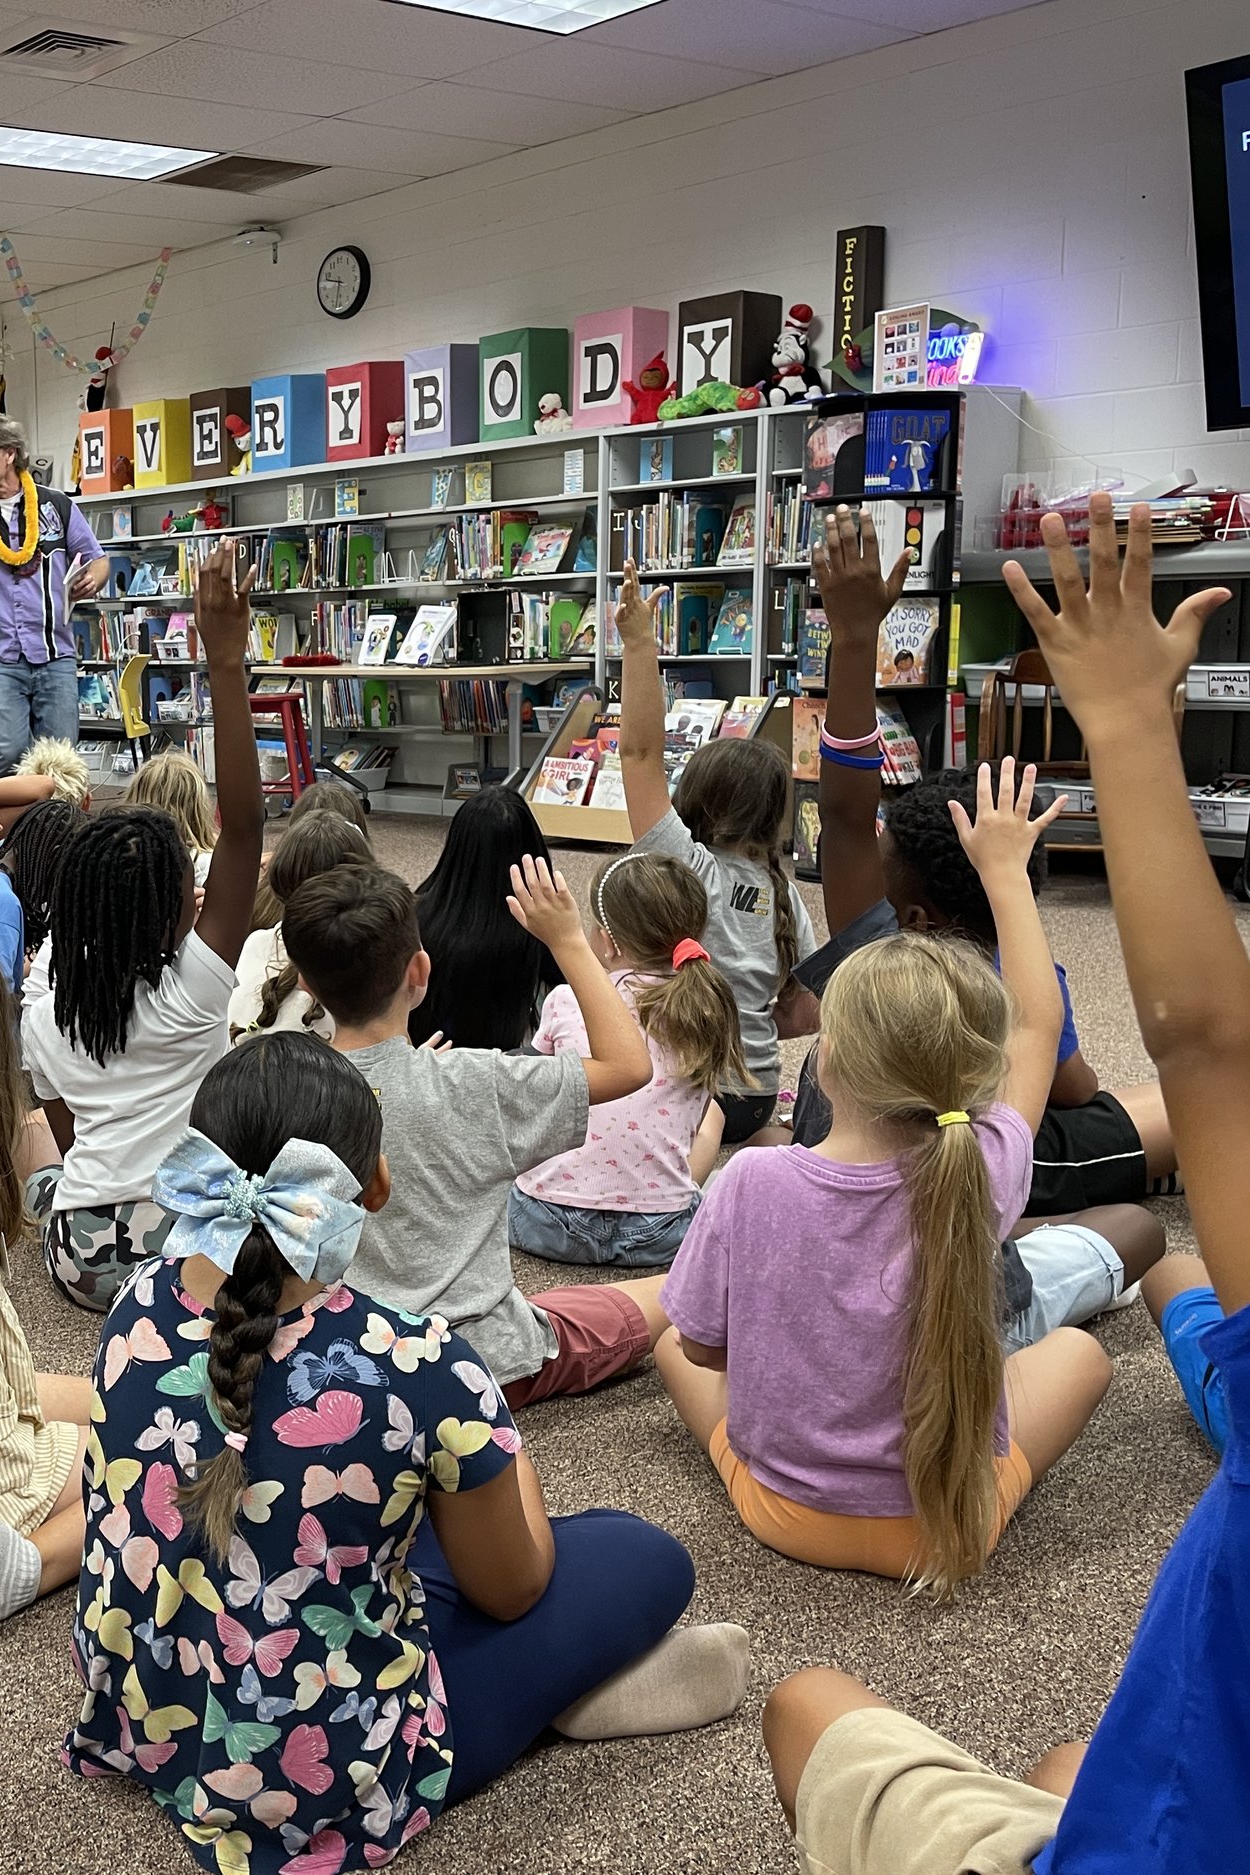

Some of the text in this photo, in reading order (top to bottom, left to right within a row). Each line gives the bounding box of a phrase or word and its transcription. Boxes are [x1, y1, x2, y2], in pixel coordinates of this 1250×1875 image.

[891, 415, 946, 445] GOAT
[900, 607, 934, 622] SORRY
[886, 622, 932, 639] YOU GOT
[895, 635, 919, 650] MAD
[1211, 675, 1248, 683] ANIMALS
[550, 760, 590, 773] AMBITIOUS
[548, 769, 571, 781] GIRL
